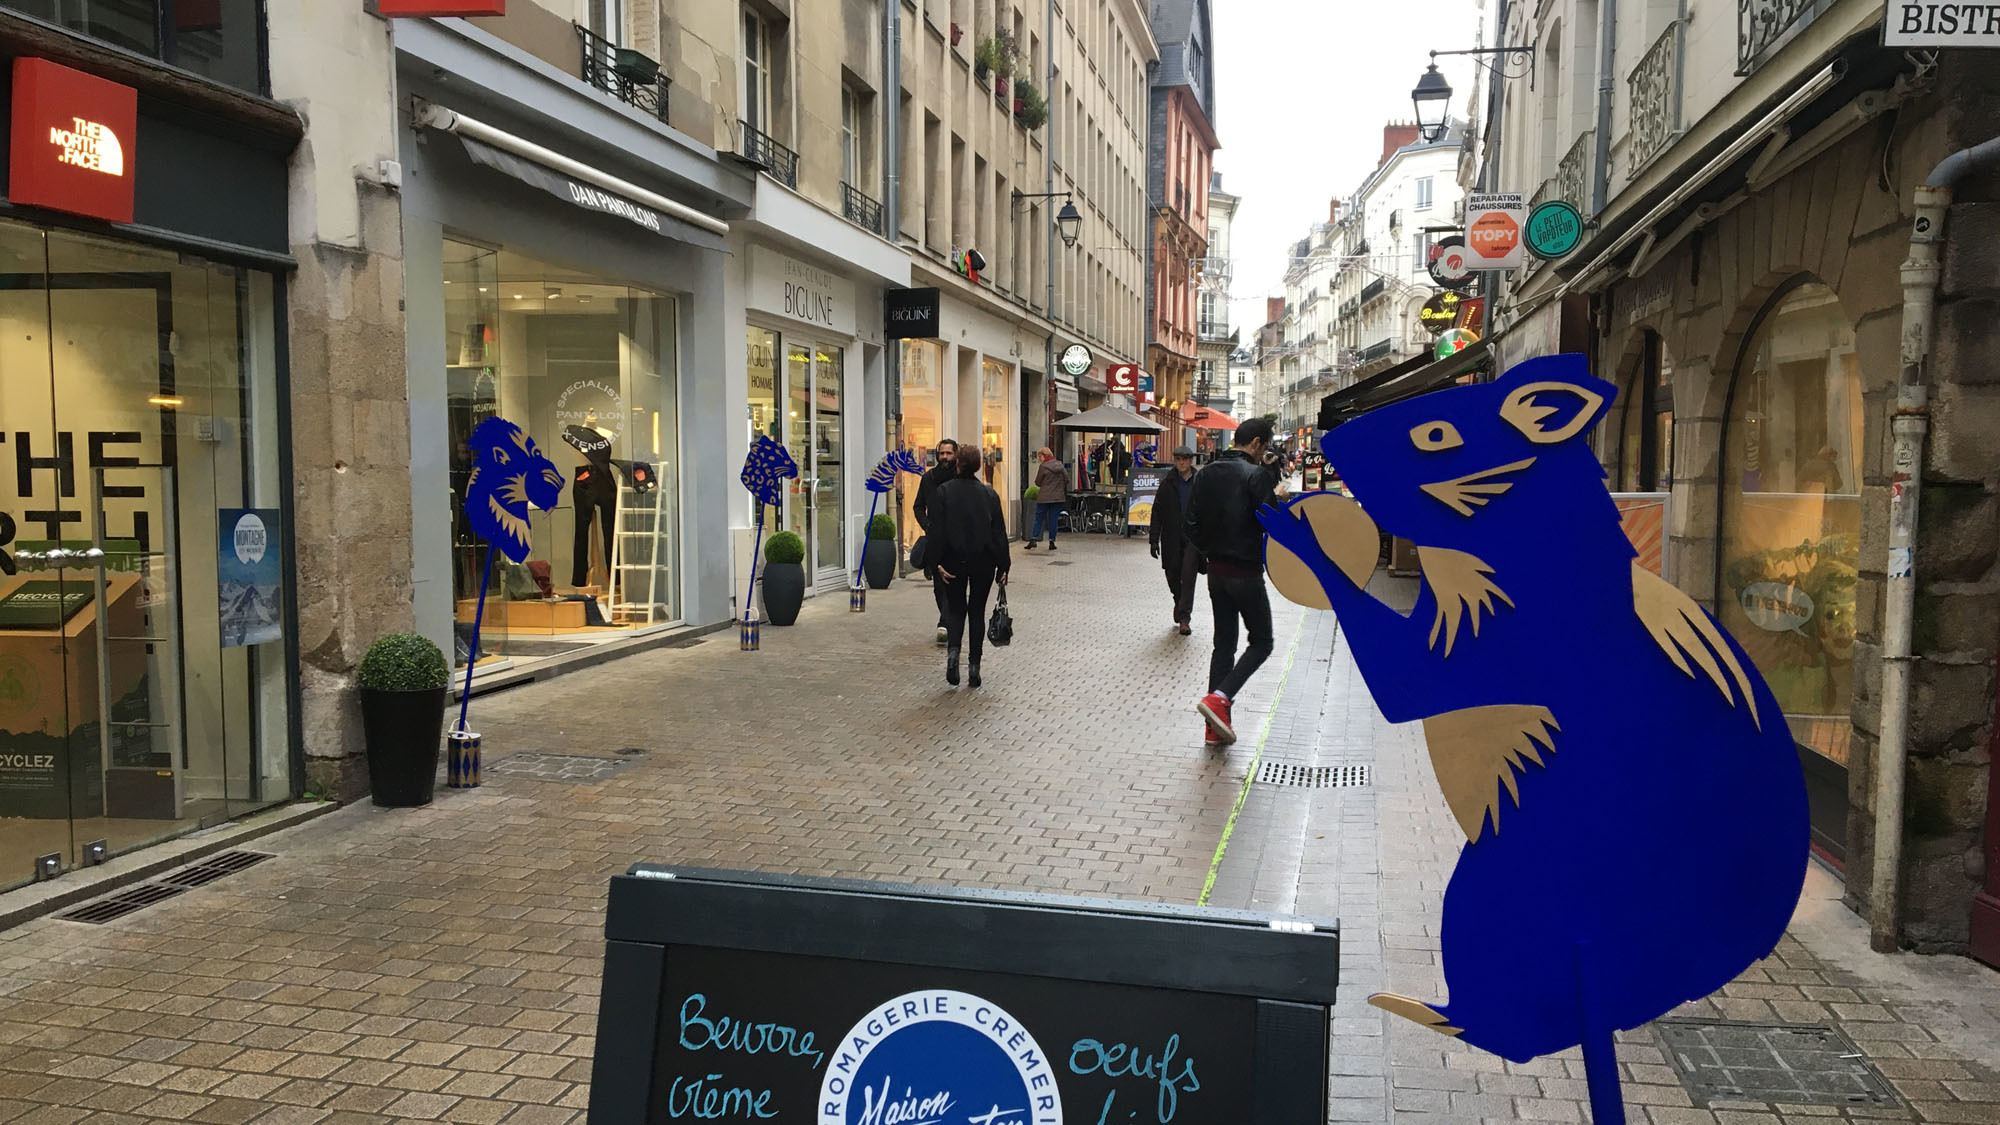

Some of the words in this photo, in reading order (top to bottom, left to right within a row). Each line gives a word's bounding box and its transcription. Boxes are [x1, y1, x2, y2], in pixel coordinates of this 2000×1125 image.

[50, 127, 101, 154] NORTH
[73, 117, 101, 140] THE
[64, 146, 101, 171] FACE
[568, 181, 600, 207] DAN
[596, 191, 660, 231] PANTALONS
[1469, 202, 1523, 211] CHAUSSURES
[1537, 219, 1574, 246] VAPOTEUR
[1543, 212, 1563, 231] PETIT
[1472, 229, 1516, 242] TOPY
[784, 259, 832, 290] JEAN-CLAUDE
[784, 281, 833, 326] BIGUINE
[751, 376, 773, 390] HOMME
[1115, 366, 1132, 386] C
[557, 380, 625, 409] SPECIALISTE
[556, 410, 625, 420] PANTALON
[557, 420, 624, 450] EXTENSIBLE
[1133, 478, 1160, 487] SOUPE
[235, 530, 265, 546] MONTAGNE
[10, 593, 85, 601] RECYCEZ
[824, 997, 948, 1120] ROMAGERIE
[857, 1075, 957, 1125] Maison
